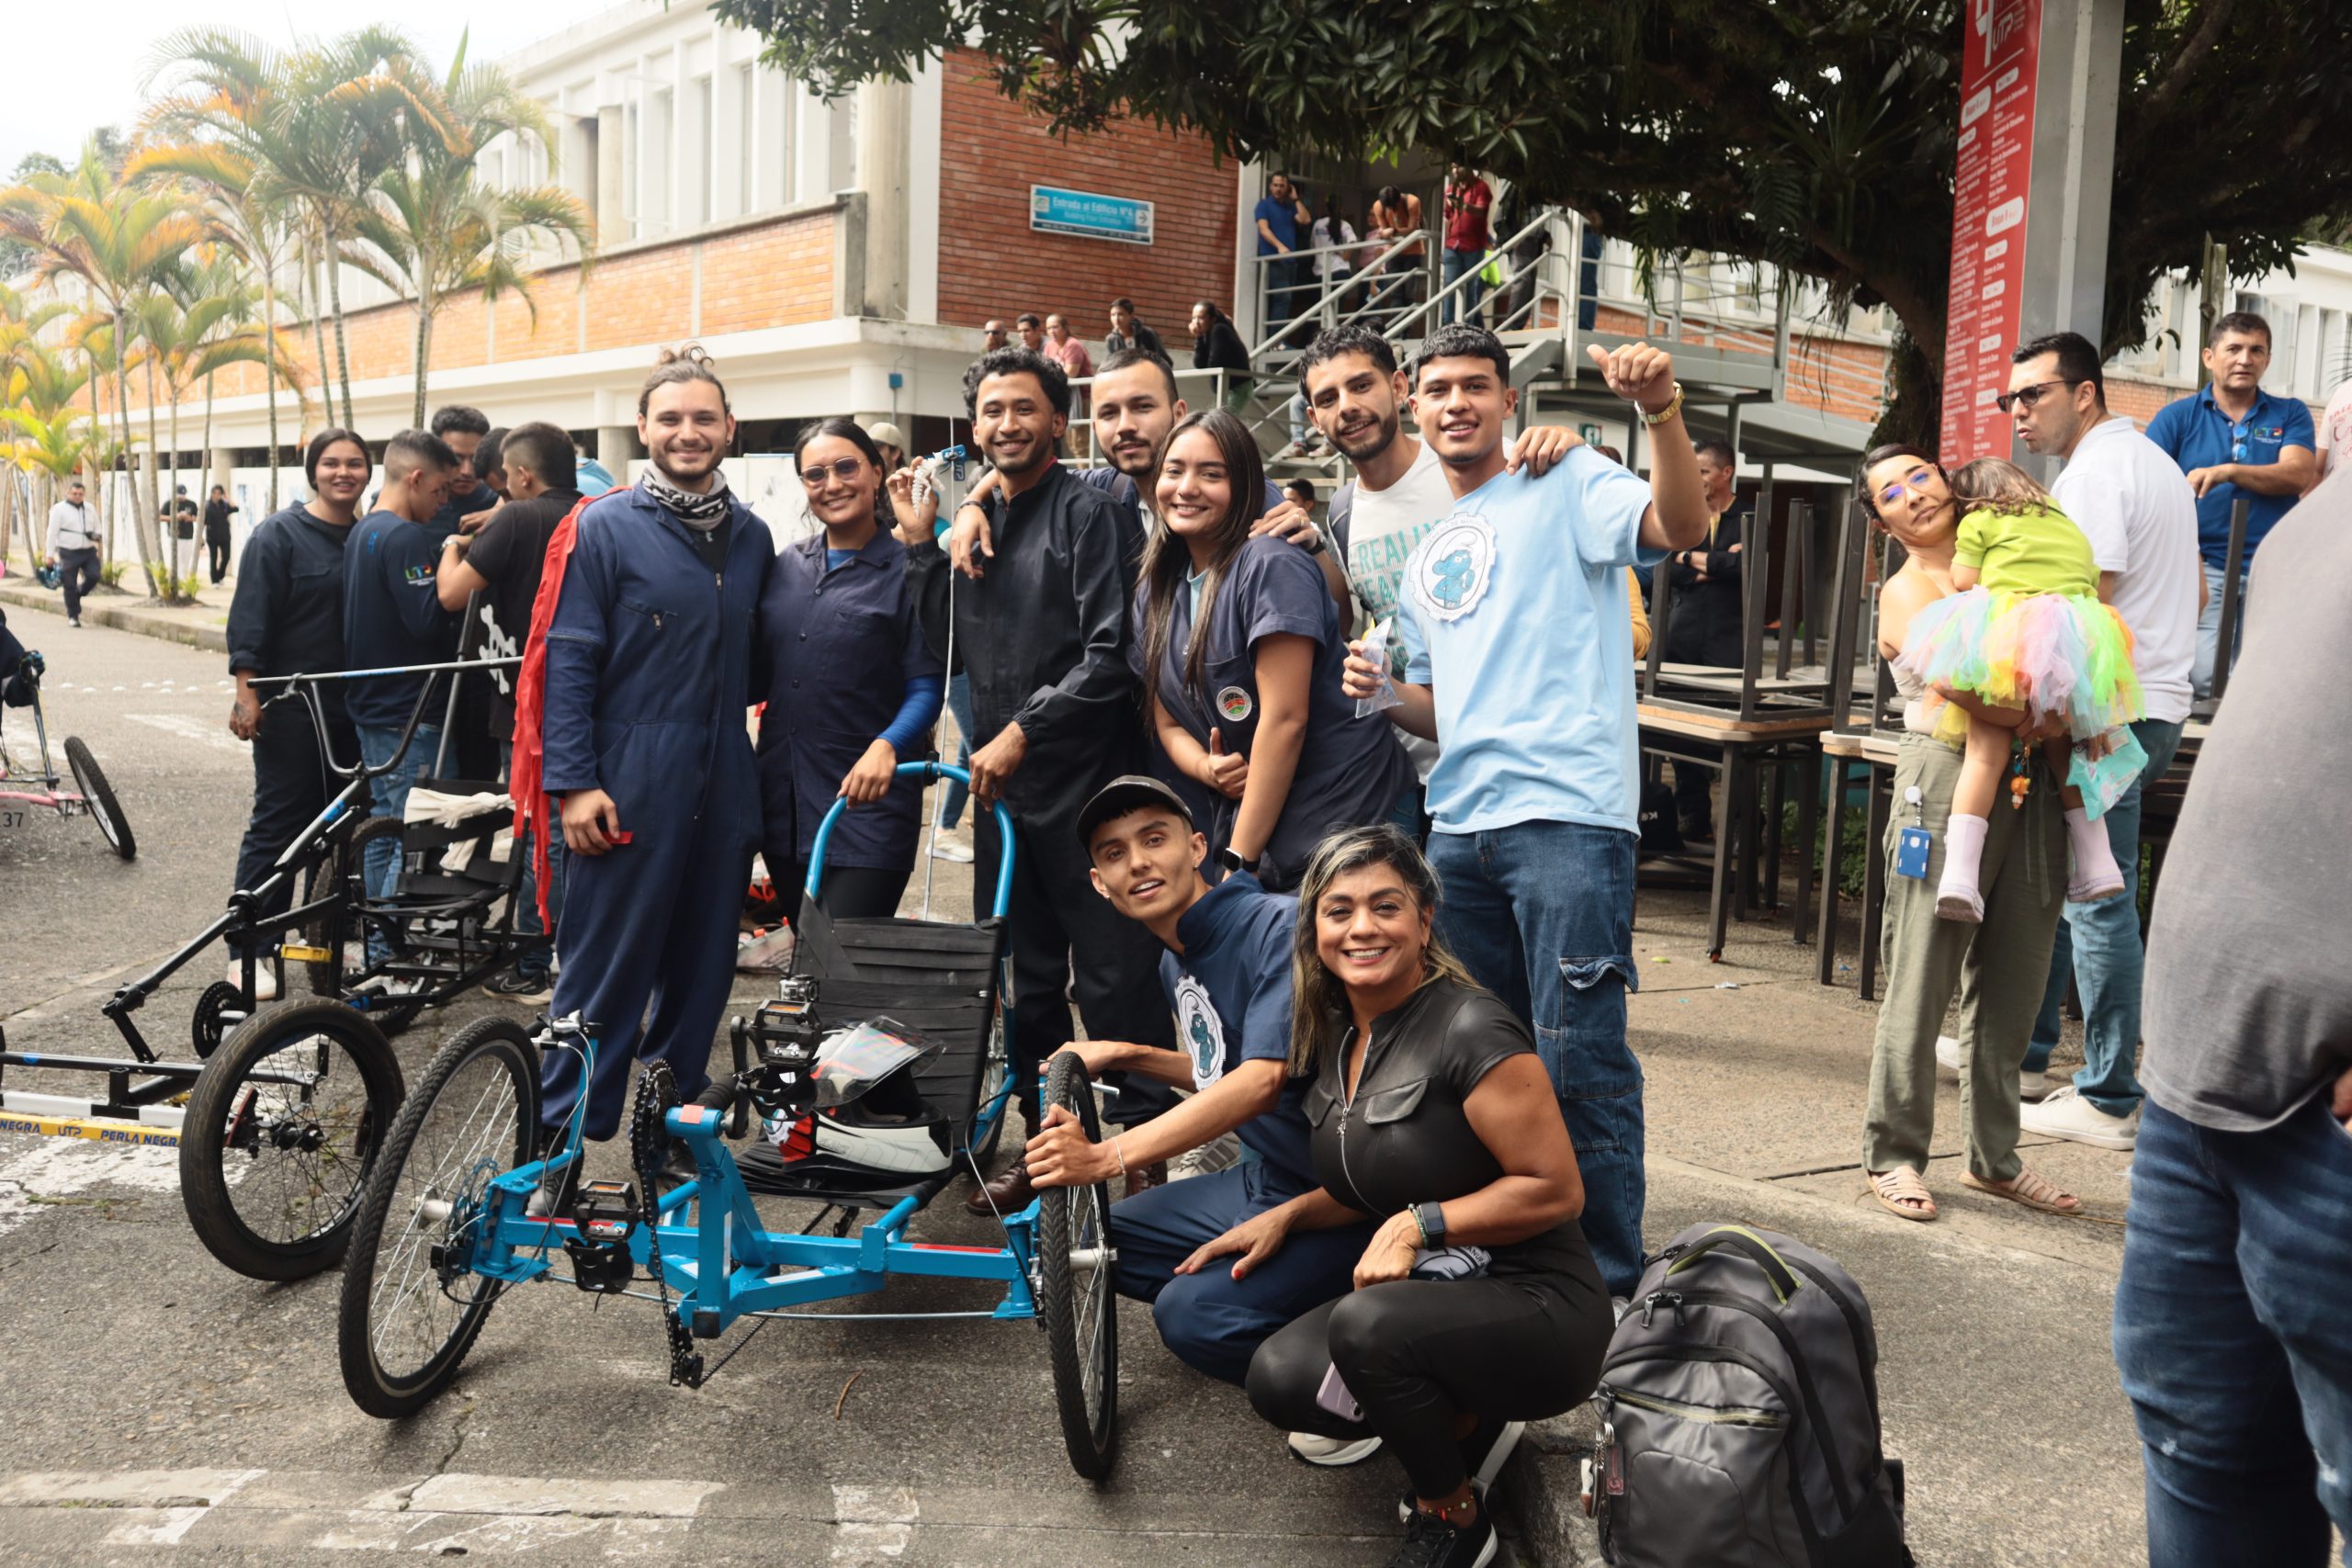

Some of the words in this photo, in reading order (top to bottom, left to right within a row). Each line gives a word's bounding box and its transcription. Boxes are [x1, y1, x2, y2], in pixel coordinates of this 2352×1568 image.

[1053, 197, 1081, 210] Entrada
[1091, 202, 1118, 215] Edificio
[405, 564, 433, 580] UTP
[0, 811, 24, 828] 37
[0, 1118, 40, 1134] NEGRA
[58, 1126, 82, 1138] UTP
[100, 1130, 140, 1145] PERLA
[143, 1134, 177, 1147] NEGR
